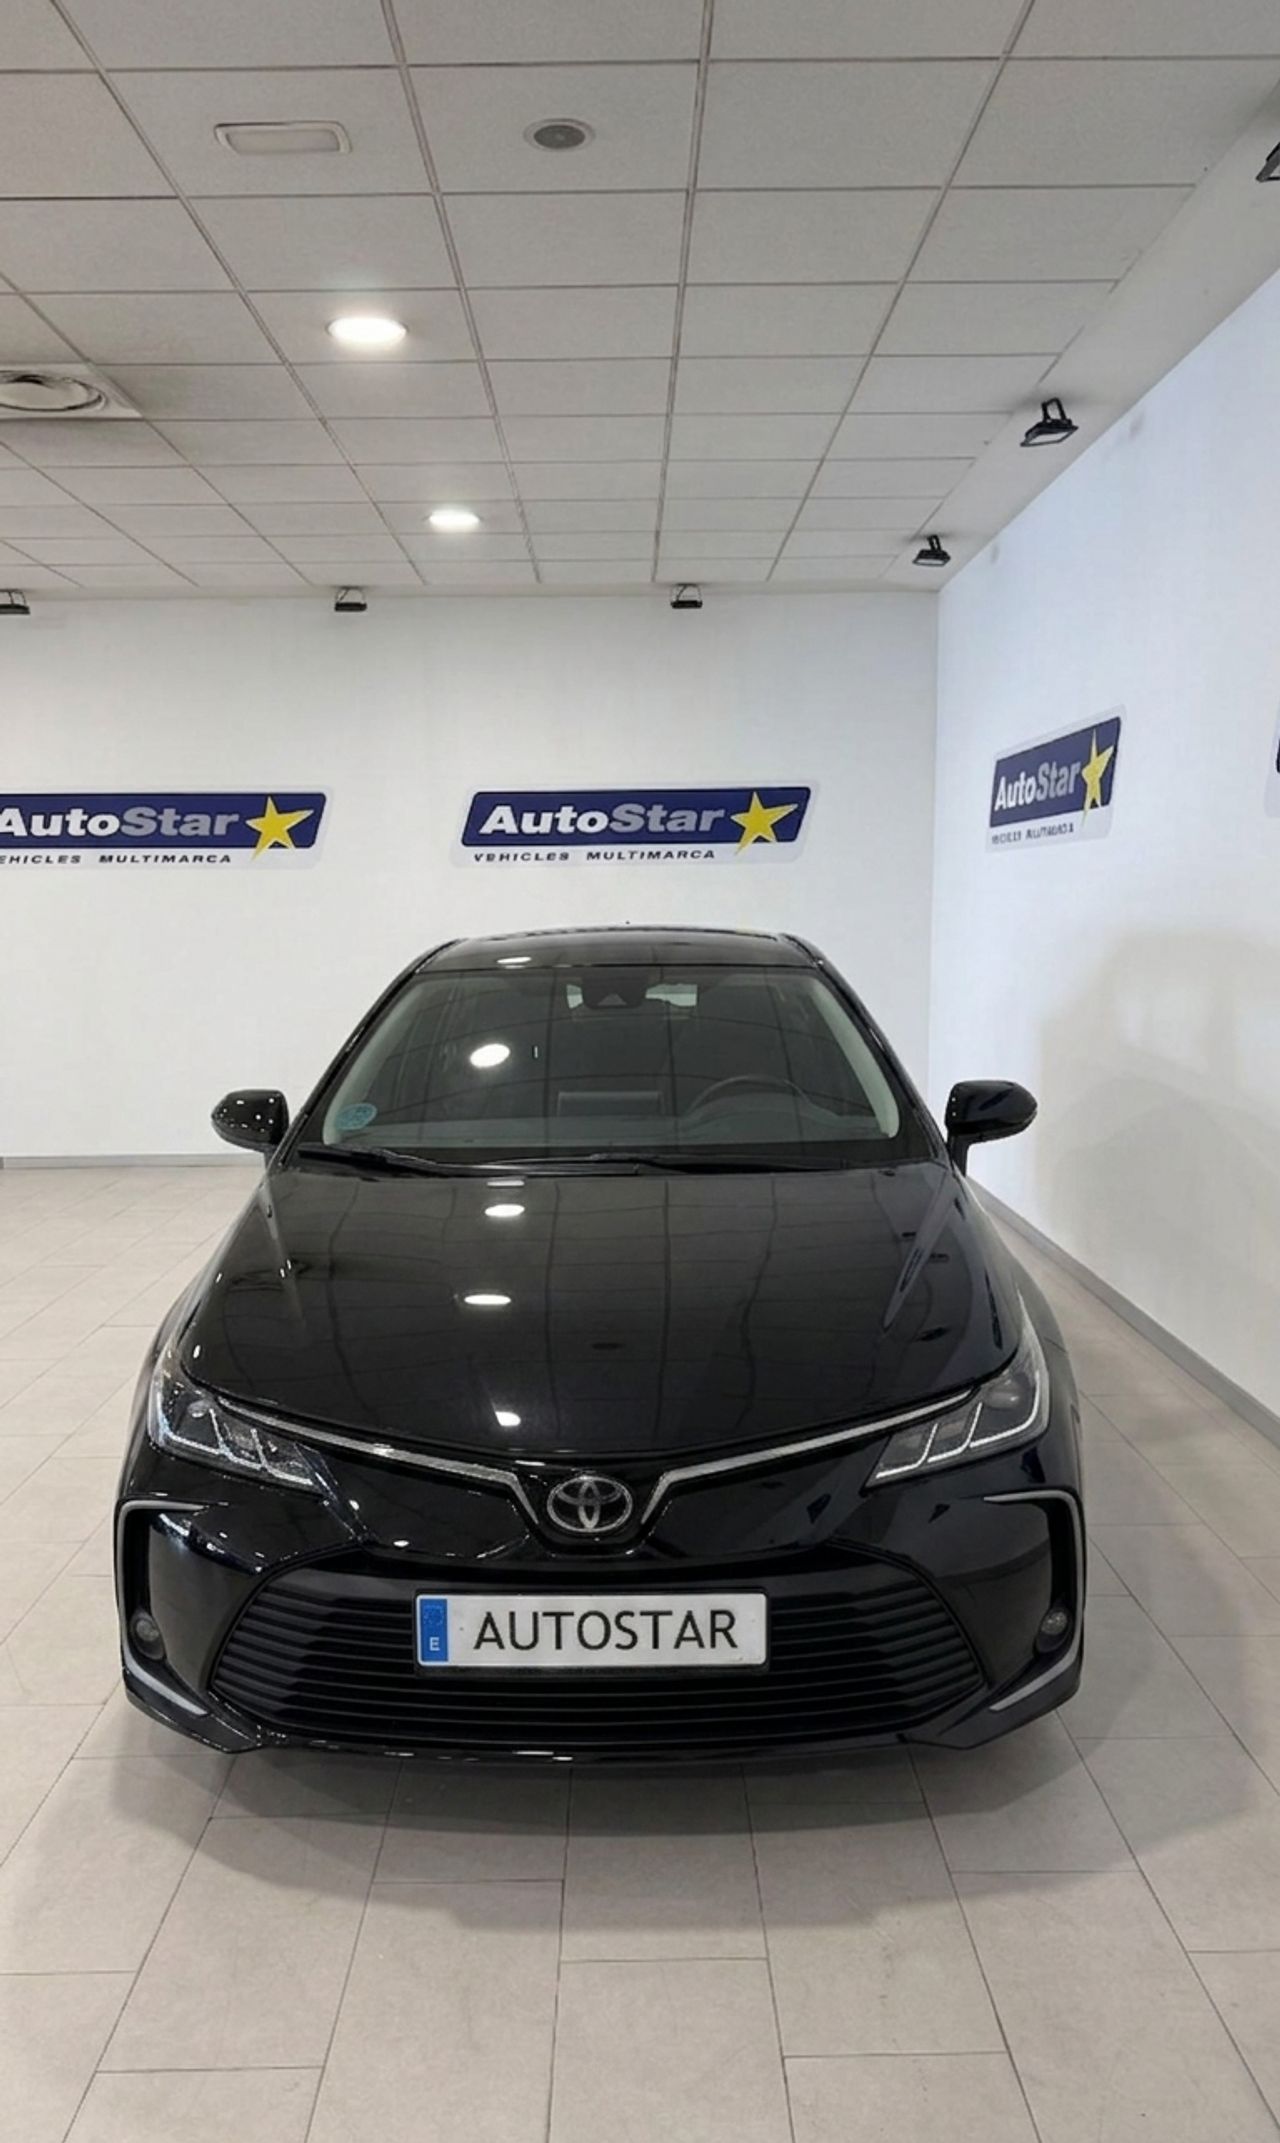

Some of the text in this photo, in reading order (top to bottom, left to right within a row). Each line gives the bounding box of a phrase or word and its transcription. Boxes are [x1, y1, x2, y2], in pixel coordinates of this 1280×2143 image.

[994, 761, 1081, 811] AutoStar
[0, 807, 239, 836] AutoStar
[479, 803, 725, 834] AutoStar
[0, 854, 231, 865] EHICLES MULTIMARCA
[474, 850, 715, 863] VEHICLES MULTIMARCA
[429, 1610, 738, 1651] E AUTOSTAR
